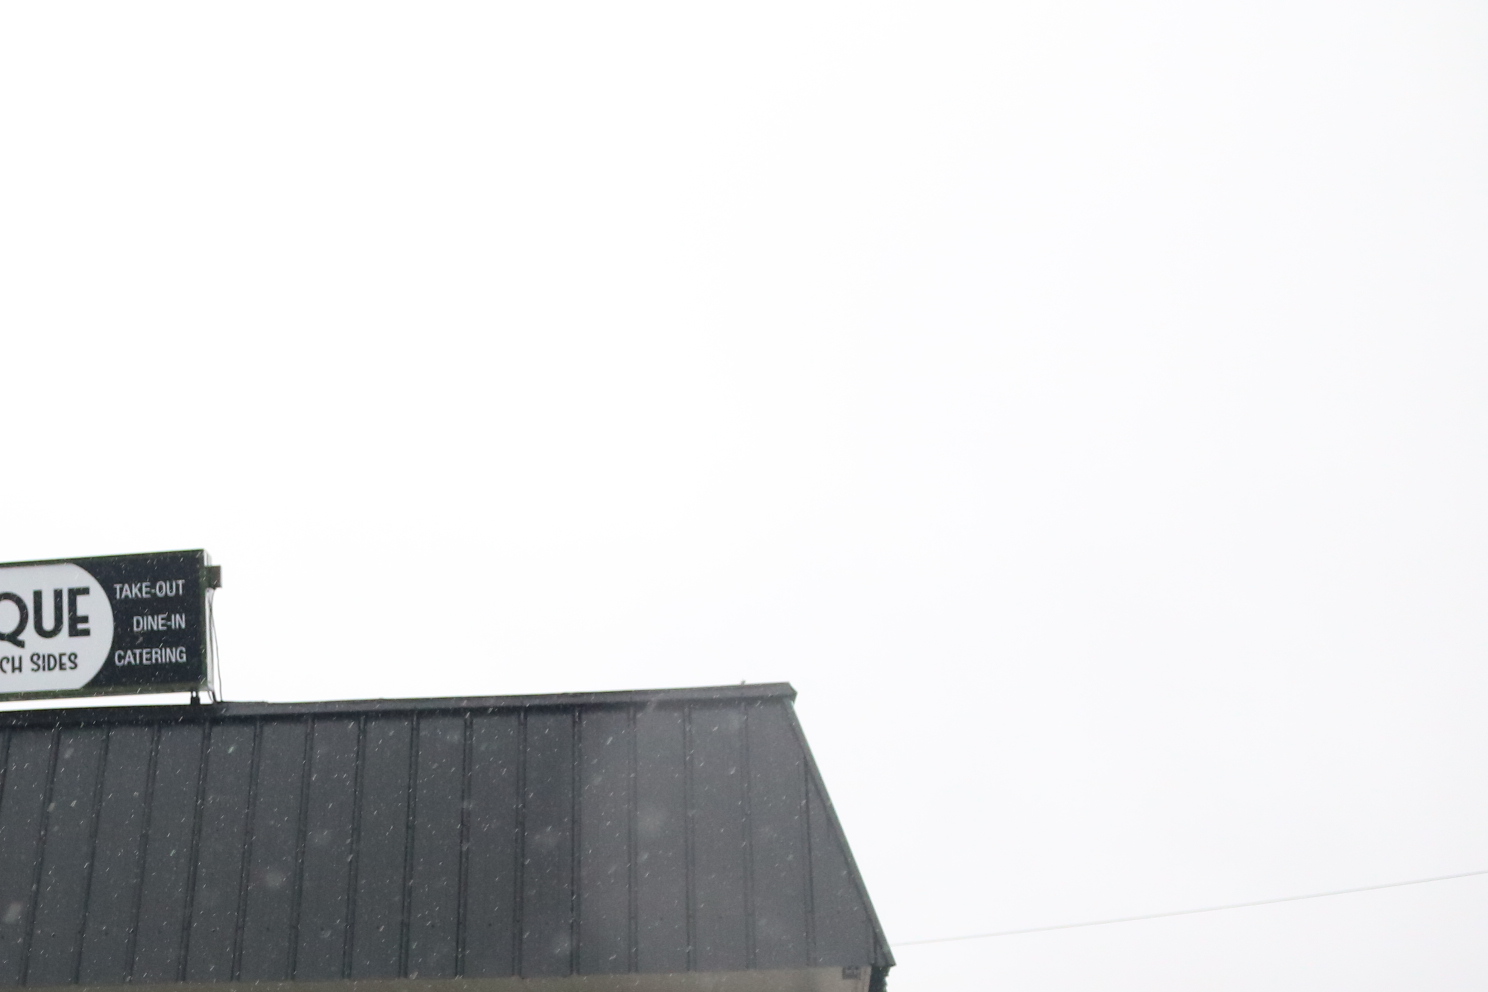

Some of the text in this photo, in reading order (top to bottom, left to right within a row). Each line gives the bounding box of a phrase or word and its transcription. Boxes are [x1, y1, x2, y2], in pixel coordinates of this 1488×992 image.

[114, 580, 185, 600] TAKE-OUT
[133, 613, 186, 632] DINE-IN
[31, 652, 78, 672] SIDES
[114, 646, 186, 666] CATERING
